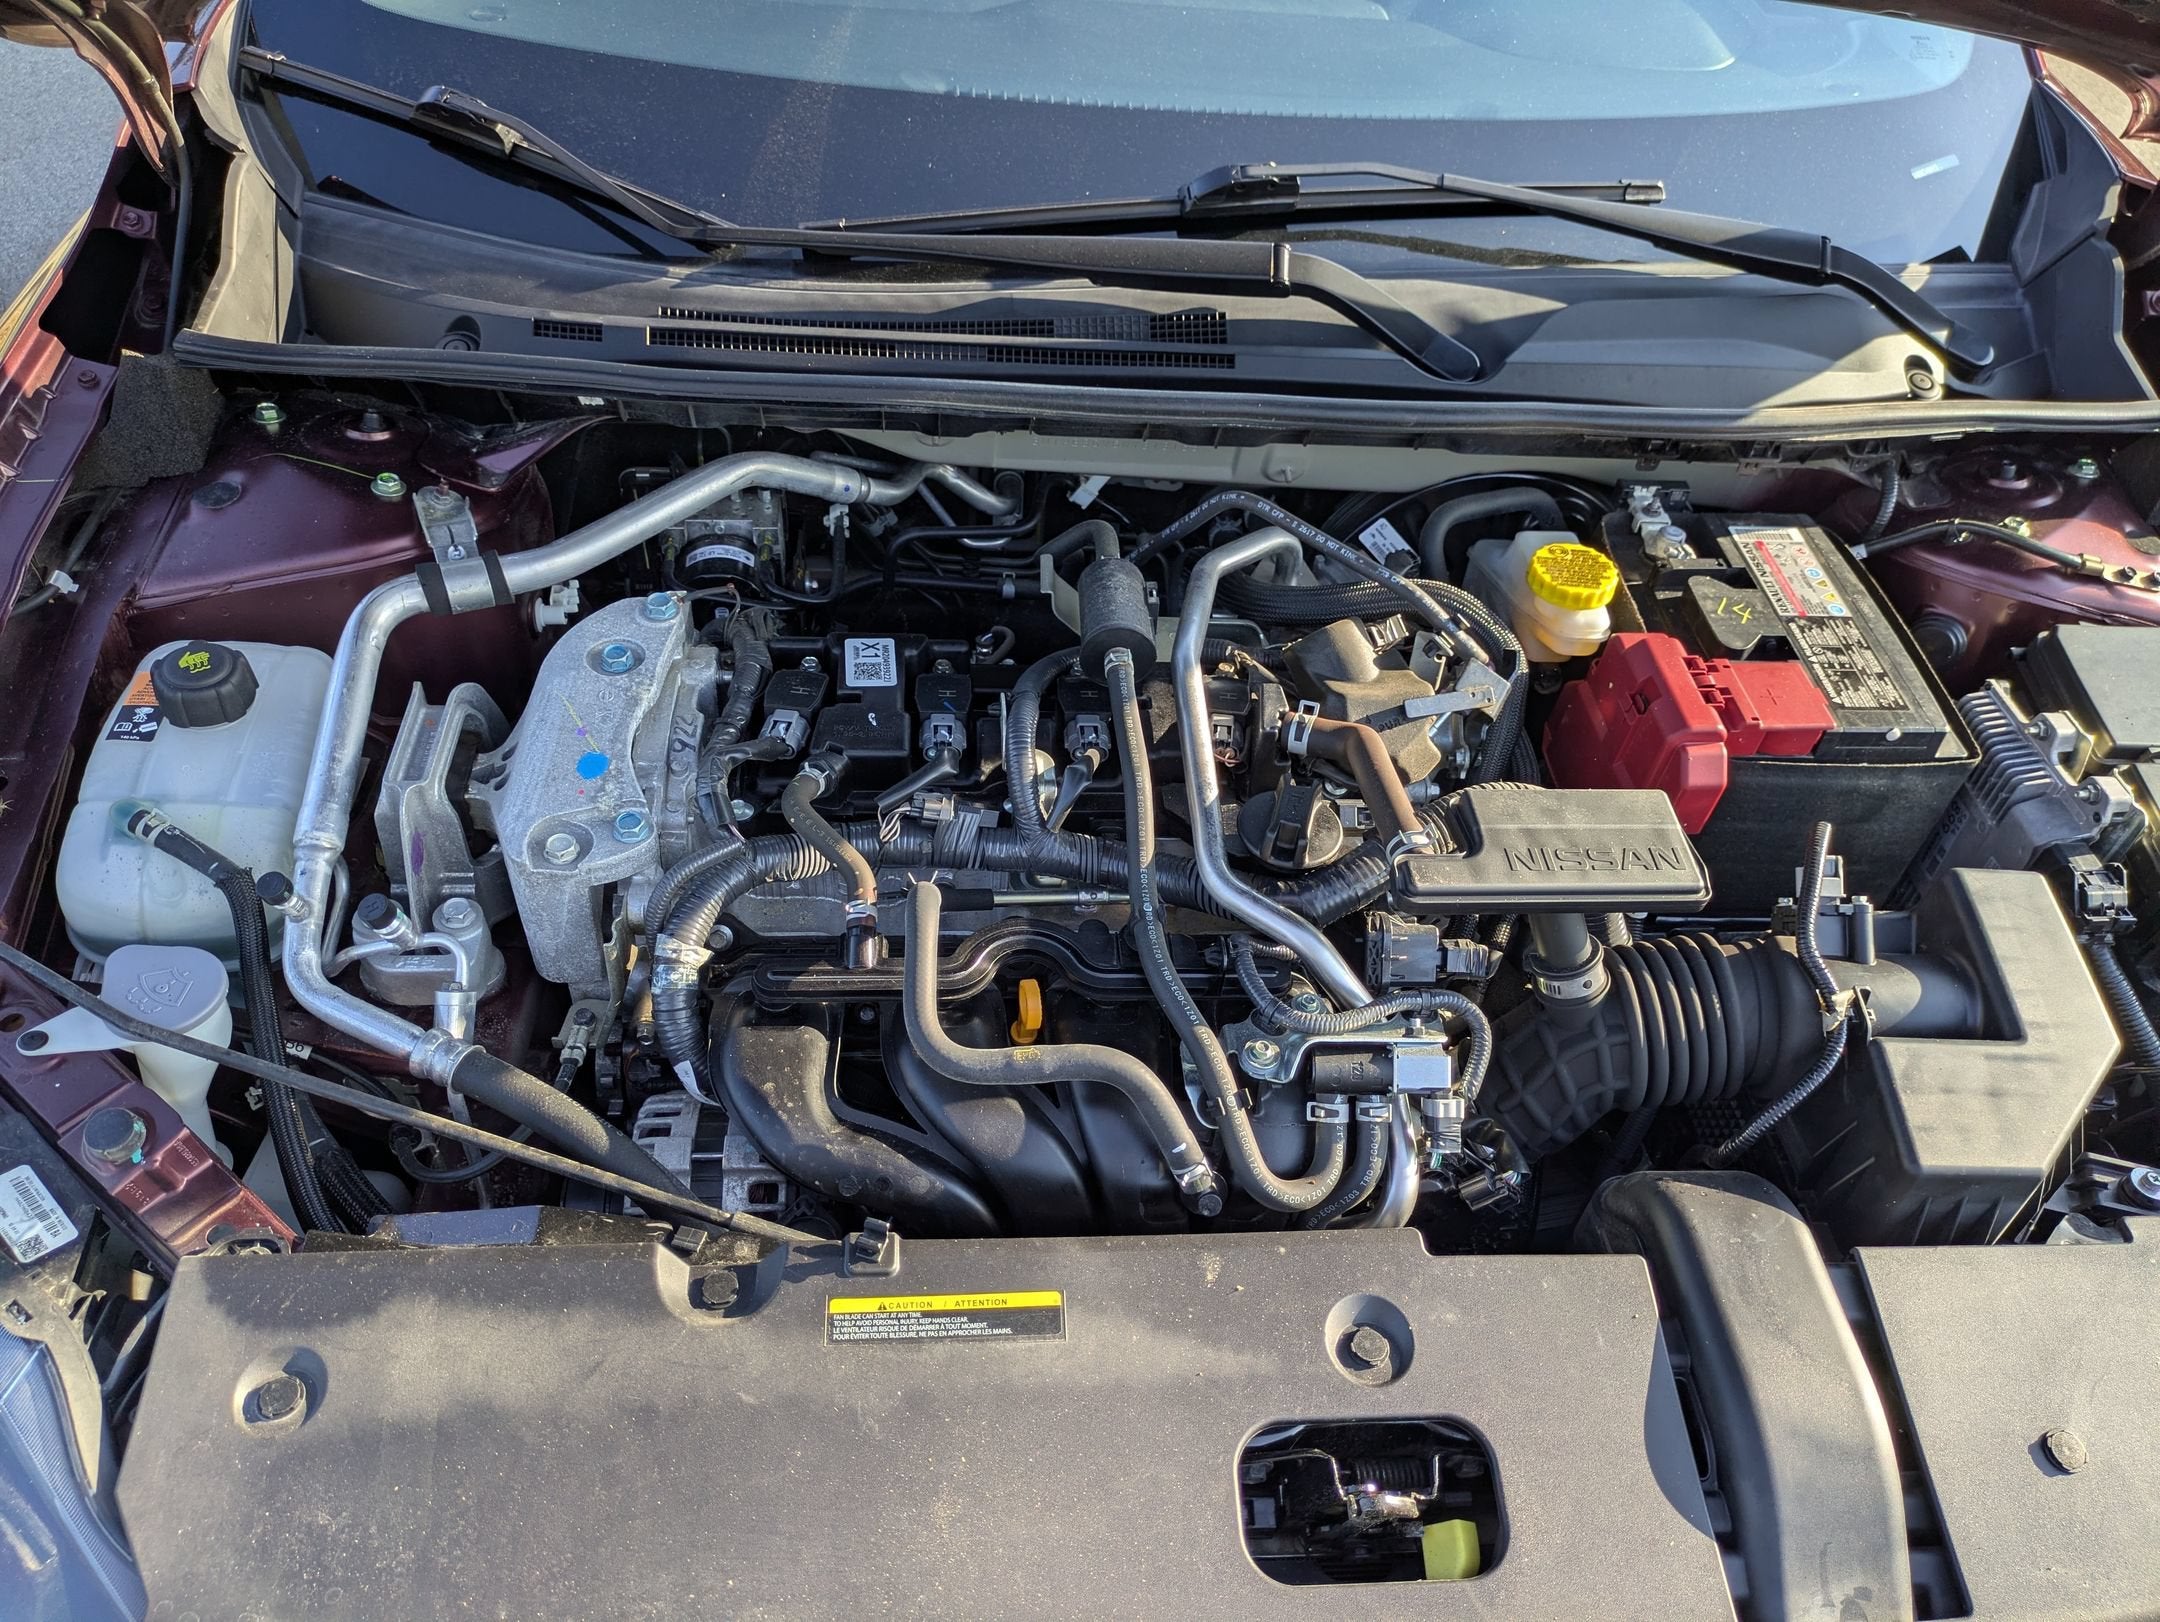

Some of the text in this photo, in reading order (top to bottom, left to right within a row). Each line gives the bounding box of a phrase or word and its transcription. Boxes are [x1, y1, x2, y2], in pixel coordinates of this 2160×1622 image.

[1326, 540, 1340, 552] NOT
[1741, 541, 1791, 615] RENAULT NISSAN
[1717, 597, 1752, 624] 14
[860, 641, 881, 658] X1
[1503, 847, 1687, 872] NISSAN
[888, 1301, 933, 1310] CAUTION
[954, 1299, 1008, 1308] ATTENTION
[840, 1325, 878, 1333] VENTILATEUR
